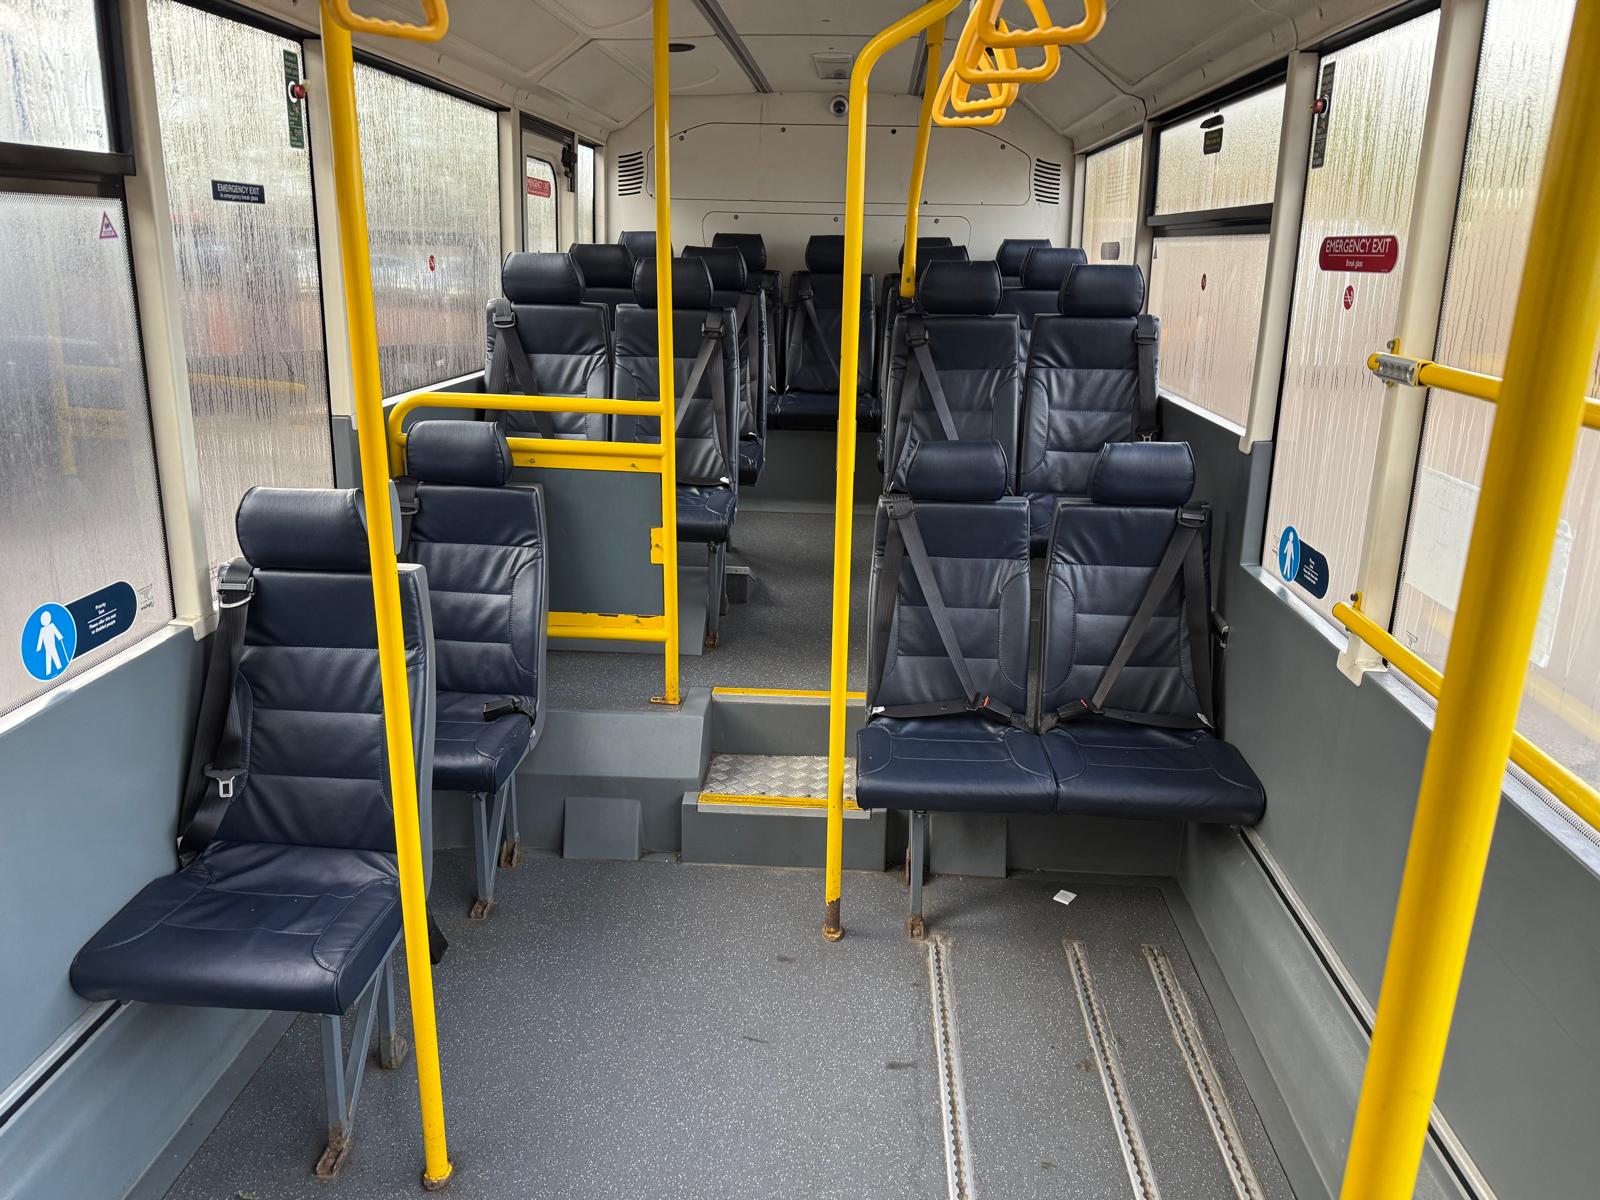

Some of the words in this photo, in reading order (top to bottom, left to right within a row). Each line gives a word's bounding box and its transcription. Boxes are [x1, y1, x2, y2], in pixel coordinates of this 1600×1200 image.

[217, 183, 249, 194] EMERGENCY
[249, 186, 260, 195] EXIT
[1325, 239, 1371, 253] EMERGENCY
[1371, 238, 1392, 253] EXIT
